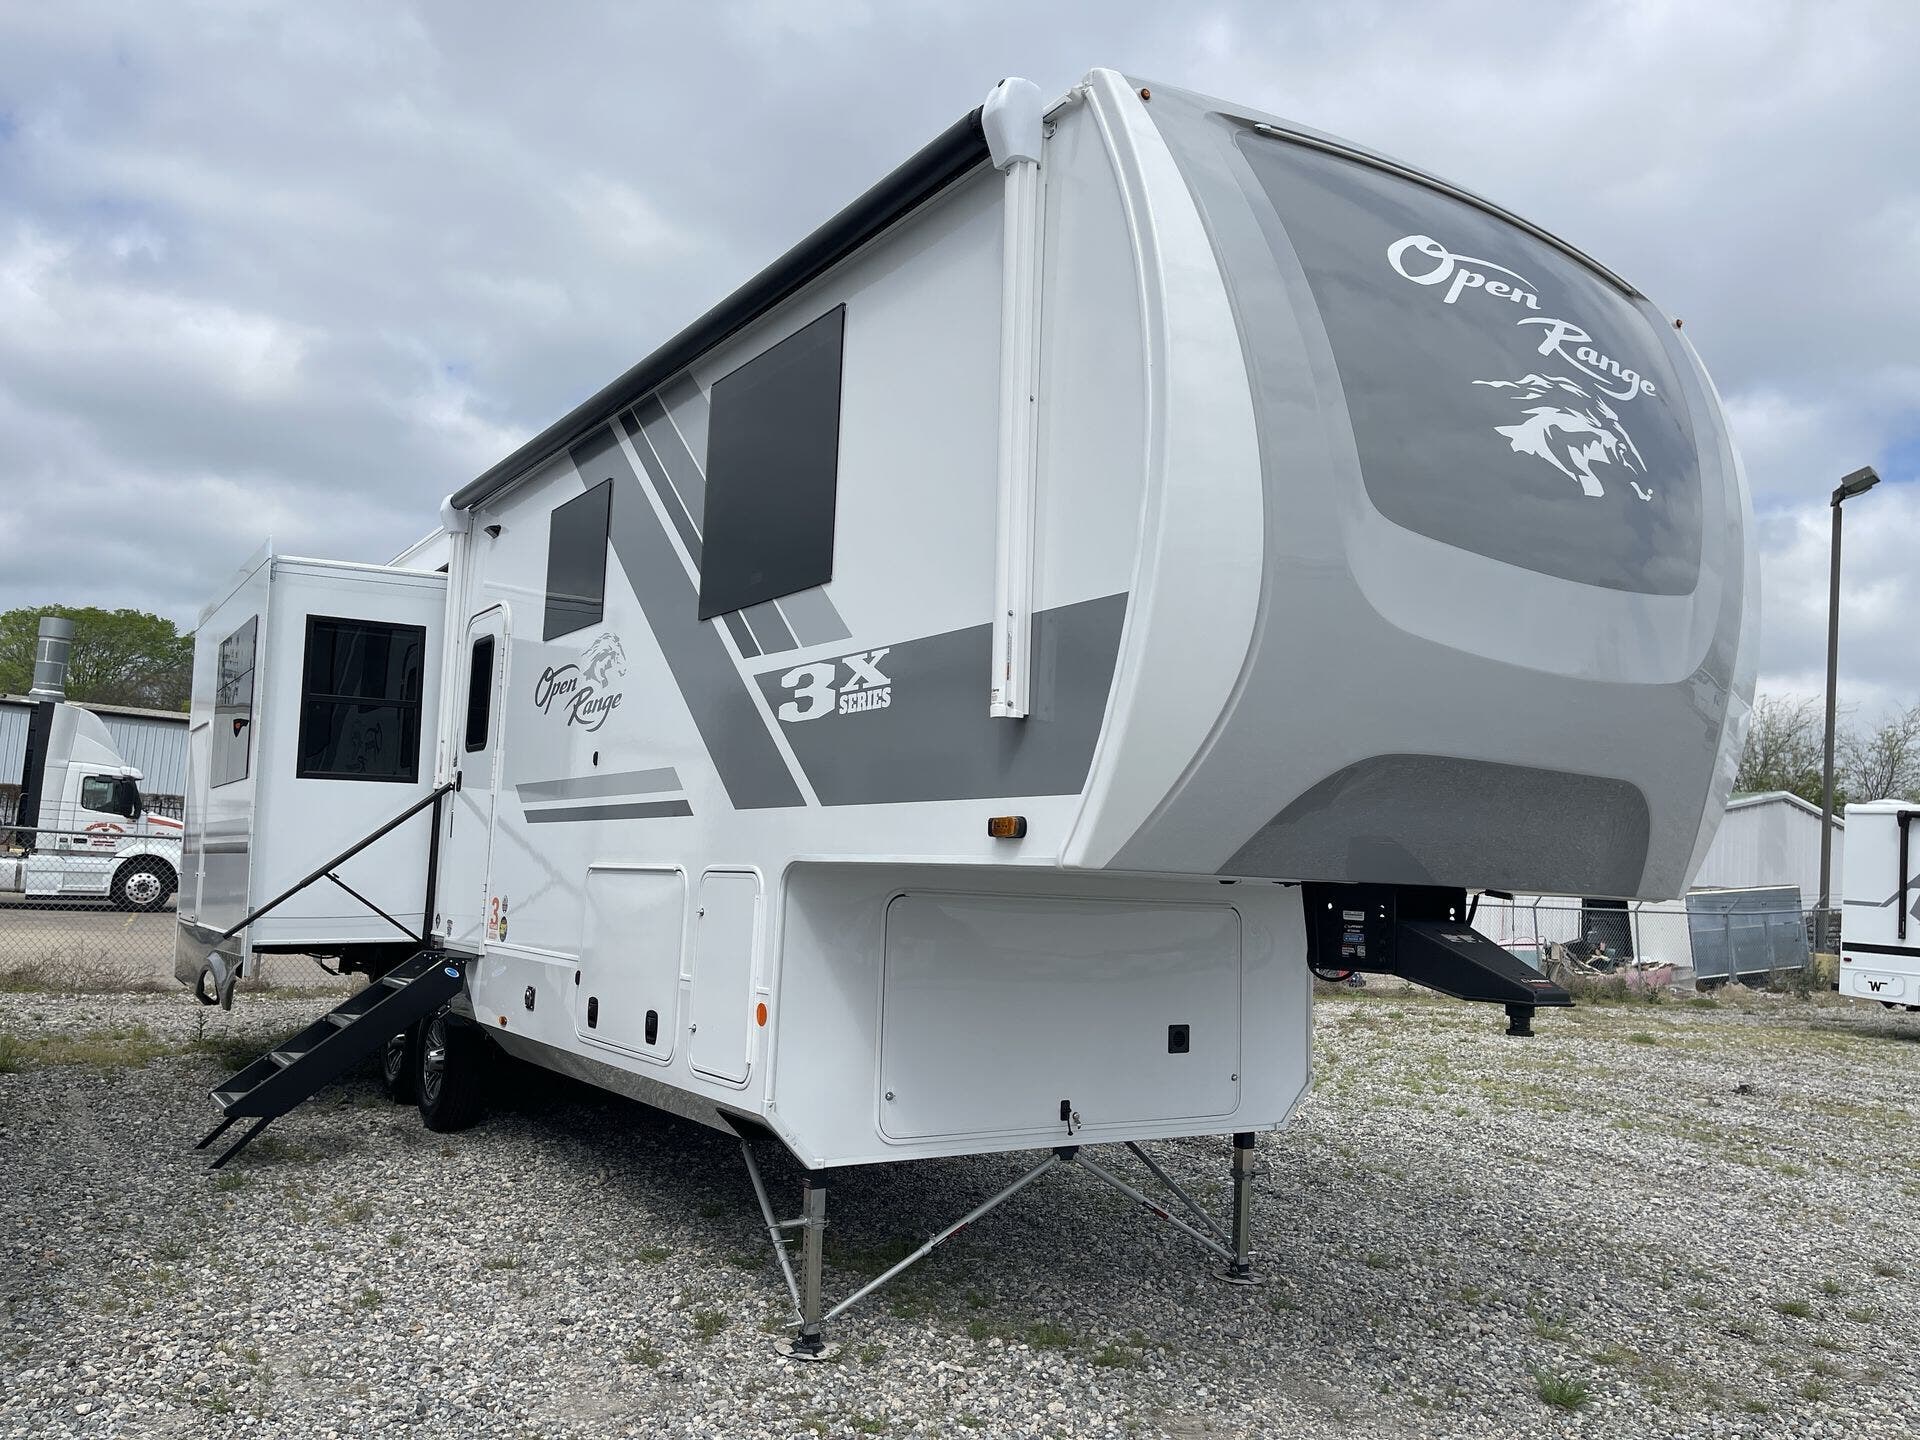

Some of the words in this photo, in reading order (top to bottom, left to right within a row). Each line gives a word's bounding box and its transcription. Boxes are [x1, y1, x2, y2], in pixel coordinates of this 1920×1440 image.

[1387, 234, 1541, 310] Open
[1516, 317, 1656, 401] Range
[535, 664, 580, 715] Open
[563, 686, 622, 732] Range
[839, 687, 891, 715] SERIES
